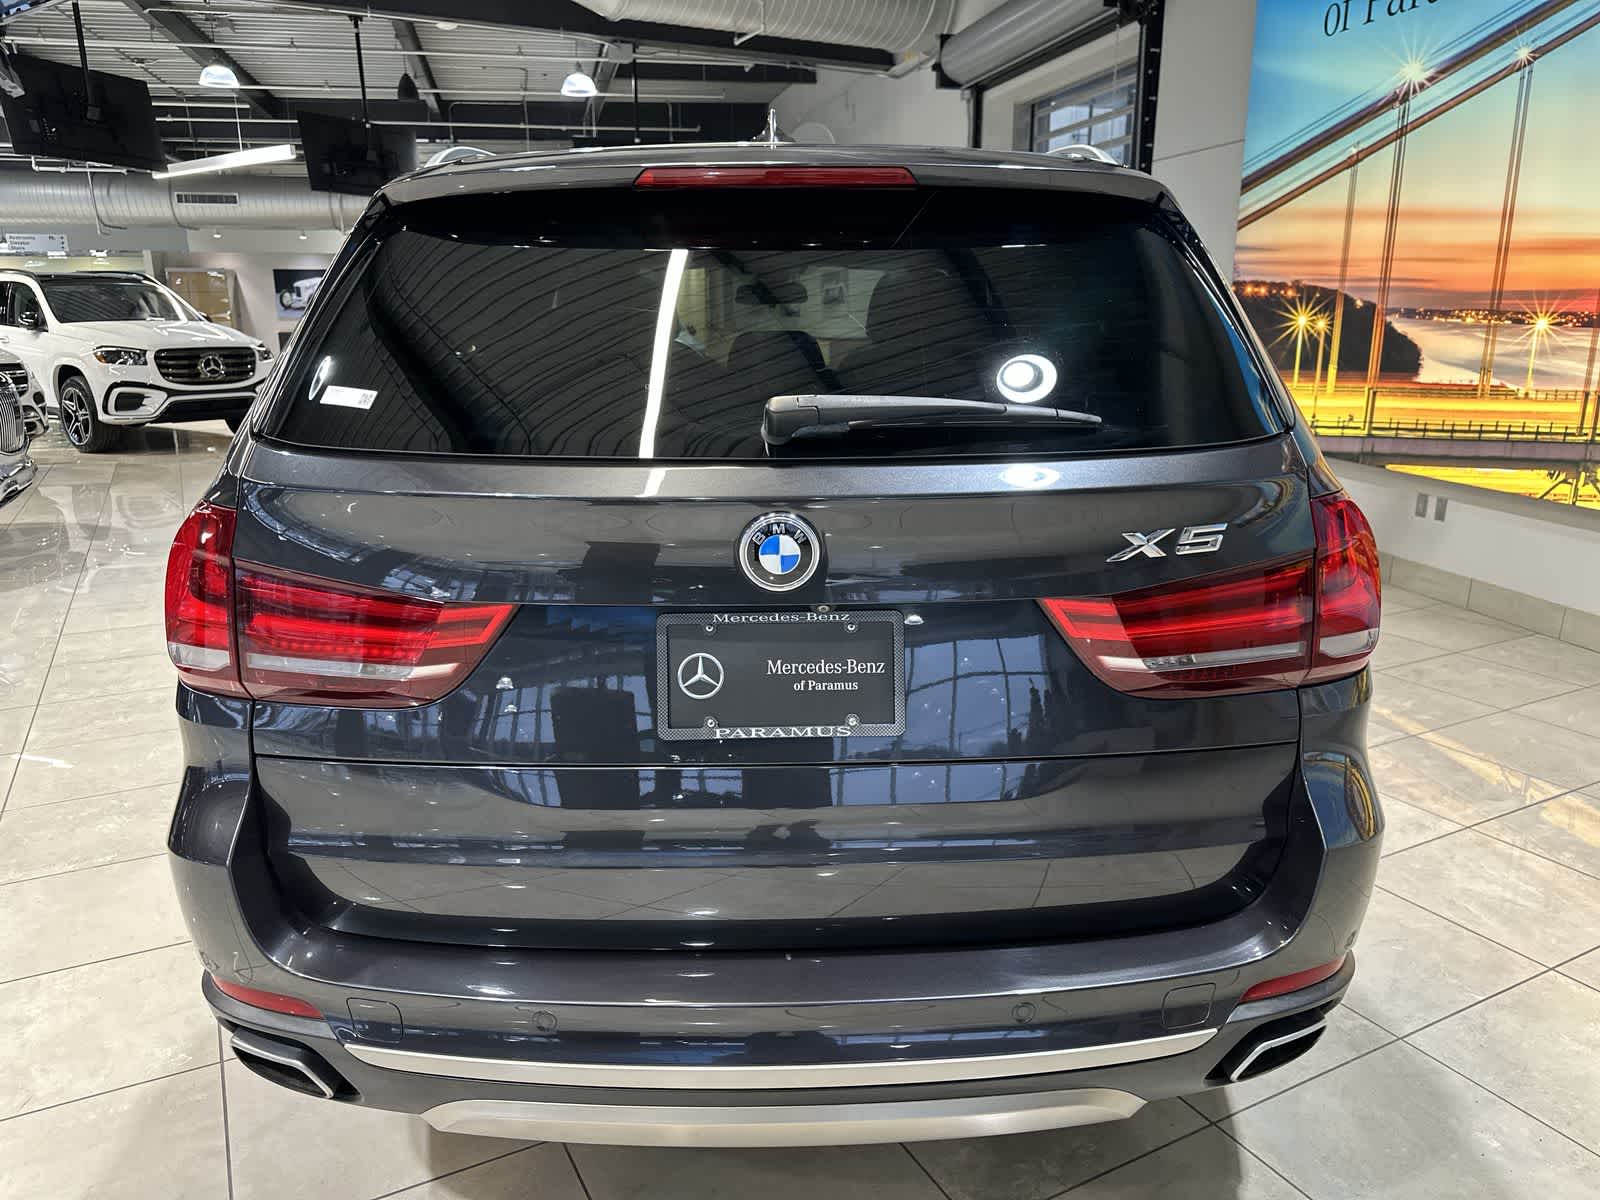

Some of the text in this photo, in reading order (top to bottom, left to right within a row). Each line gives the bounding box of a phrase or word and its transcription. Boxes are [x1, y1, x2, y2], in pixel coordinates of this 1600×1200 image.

[751, 522, 808, 546] BMW
[1105, 522, 1229, 562] X5
[712, 612, 851, 624] Mercedes-Benz
[766, 658, 886, 676] Mercedes-Benz
[793, 679, 859, 692] of Paramus
[713, 725, 853, 739] PARAMUS
